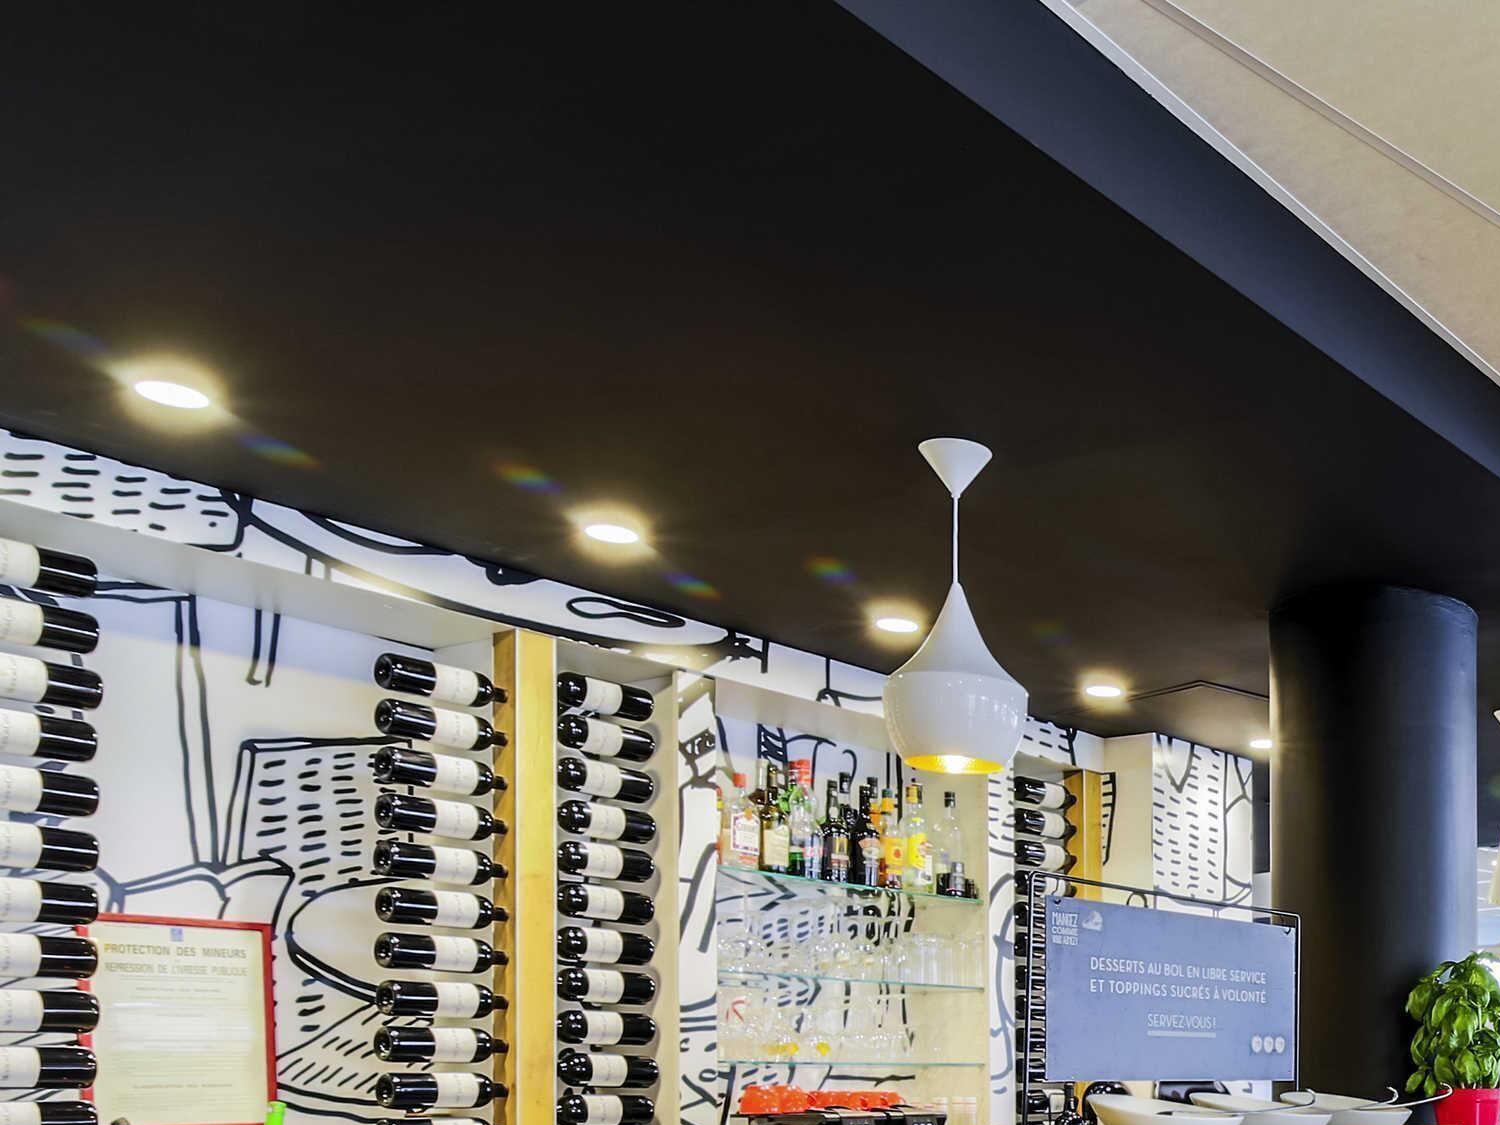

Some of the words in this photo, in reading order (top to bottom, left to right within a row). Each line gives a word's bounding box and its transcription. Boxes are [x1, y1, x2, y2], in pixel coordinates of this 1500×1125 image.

[103, 943, 170, 956] PROTECTION
[176, 946, 196, 957] DES
[202, 947, 247, 959] MINEURS
[1090, 956, 1145, 975] DESSERTS
[1147, 962, 1162, 976] AU
[1164, 964, 1185, 978] BOL
[1186, 965, 1200, 979] EN
[1202, 967, 1227, 981] LIBRE
[1229, 970, 1267, 985] SERVICE
[1089, 979, 1105, 993] ET
[1108, 980, 1168, 997] TOPPINGS
[1170, 983, 1210, 1000] SUCRÉS
[1213, 986, 1220, 1001] À
[1221, 988, 1267, 1004] VOLONTÉ
